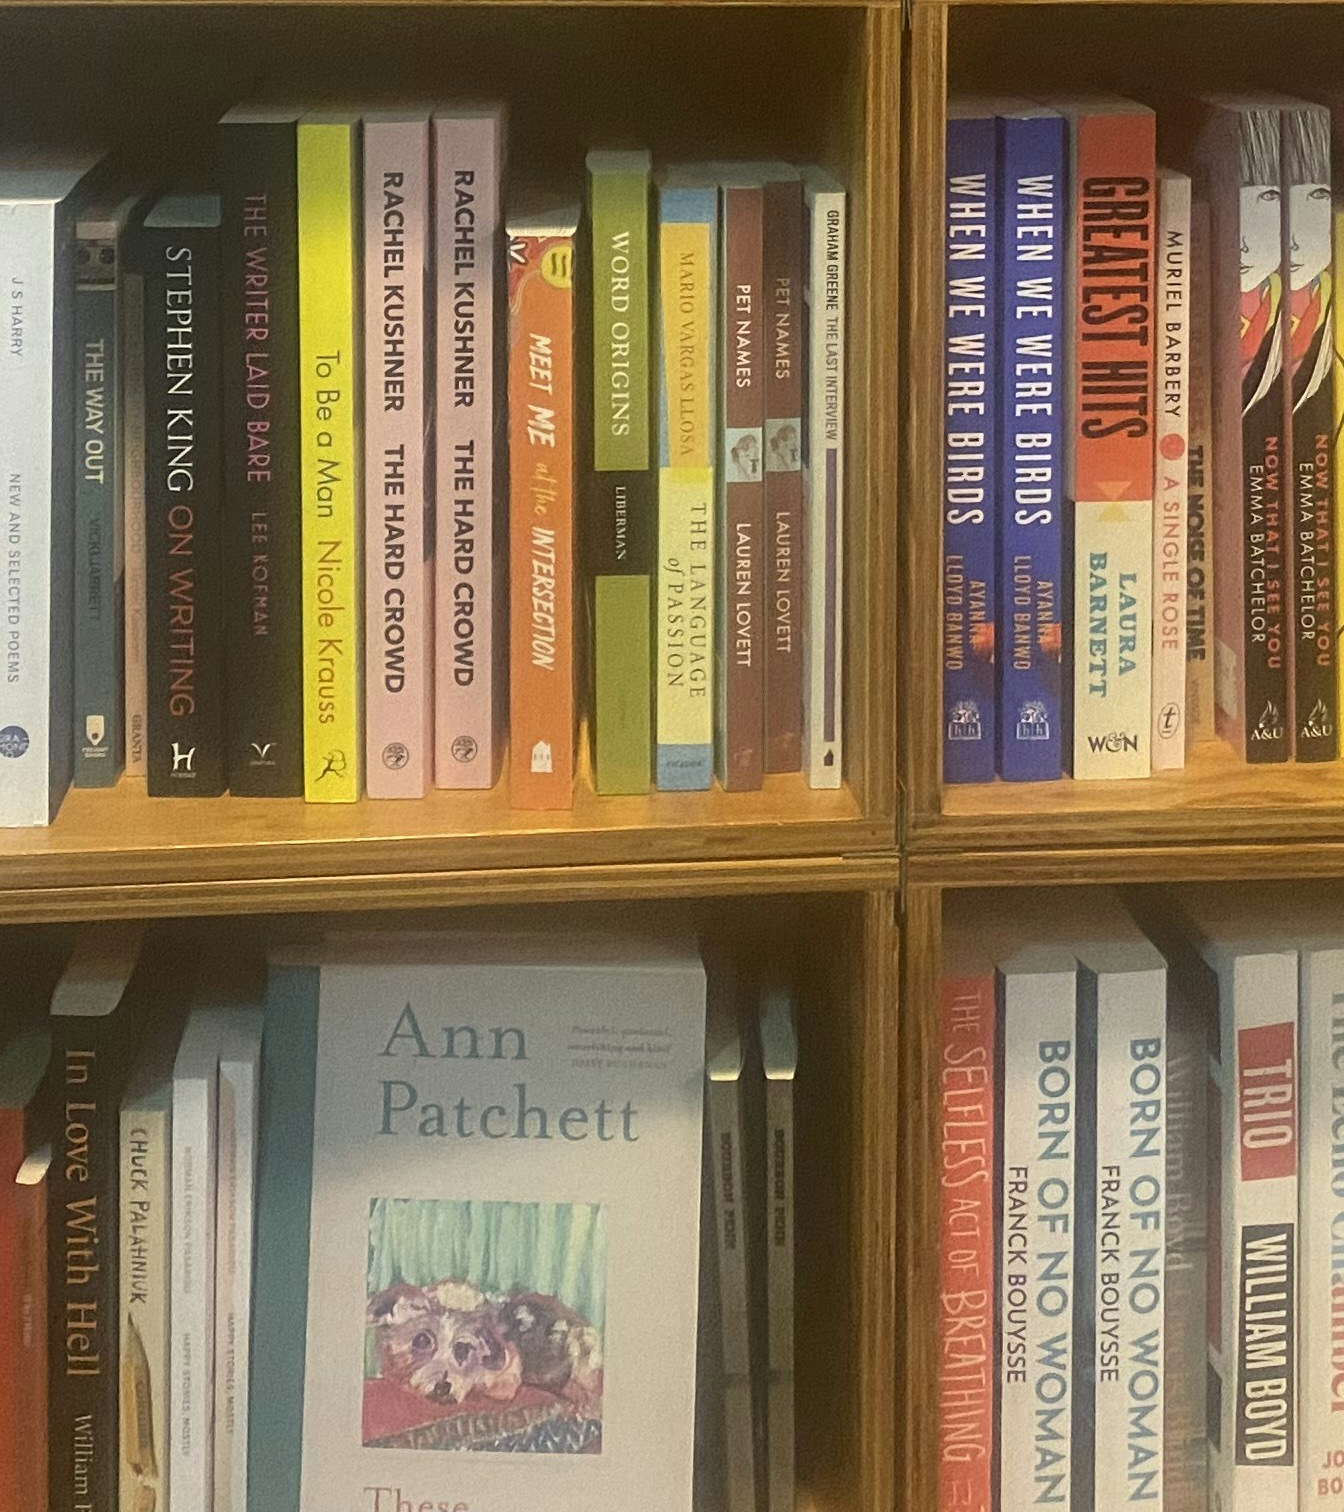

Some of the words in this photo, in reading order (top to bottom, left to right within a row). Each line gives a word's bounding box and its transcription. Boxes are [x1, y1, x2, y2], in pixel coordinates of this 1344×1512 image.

[453, 170, 477, 274] RACHEL
[1083, 176, 1151, 351] GREATEST
[1166, 231, 1183, 312] MURIEL
[164, 246, 195, 397] STEPHEN
[454, 282, 477, 410] KUSHNER
[1082, 361, 1148, 440] HITS
[1165, 321, 1183, 419] BARBERY
[167, 406, 196, 494] KING
[1014, 431, 1053, 527] BIRDS
[614, 485, 627, 562] LIBERMAN
[7, 549, 20, 626] SELECTED
[1088, 552, 1108, 699] BARNETT
[1117, 573, 1136, 677] LAURA
[7, 633, 19, 684] POEMS
[380, 1001, 528, 1062] Ann
[377, 1078, 642, 1143] Patchett
[1036, 1040, 1071, 1162] BORN
[1241, 1058, 1294, 1148] TRIO
[129, 1127, 148, 1191] CHUCK
[1036, 1177, 1070, 1234] OF
[129, 1200, 149, 1306] PALAHNIUK
[1036, 1249, 1070, 1318] NO
[1244, 1232, 1289, 1371] WILLIAM
[1034, 1333, 1068, 1504] WOMAN
[1244, 1378, 1289, 1460] BOYD
